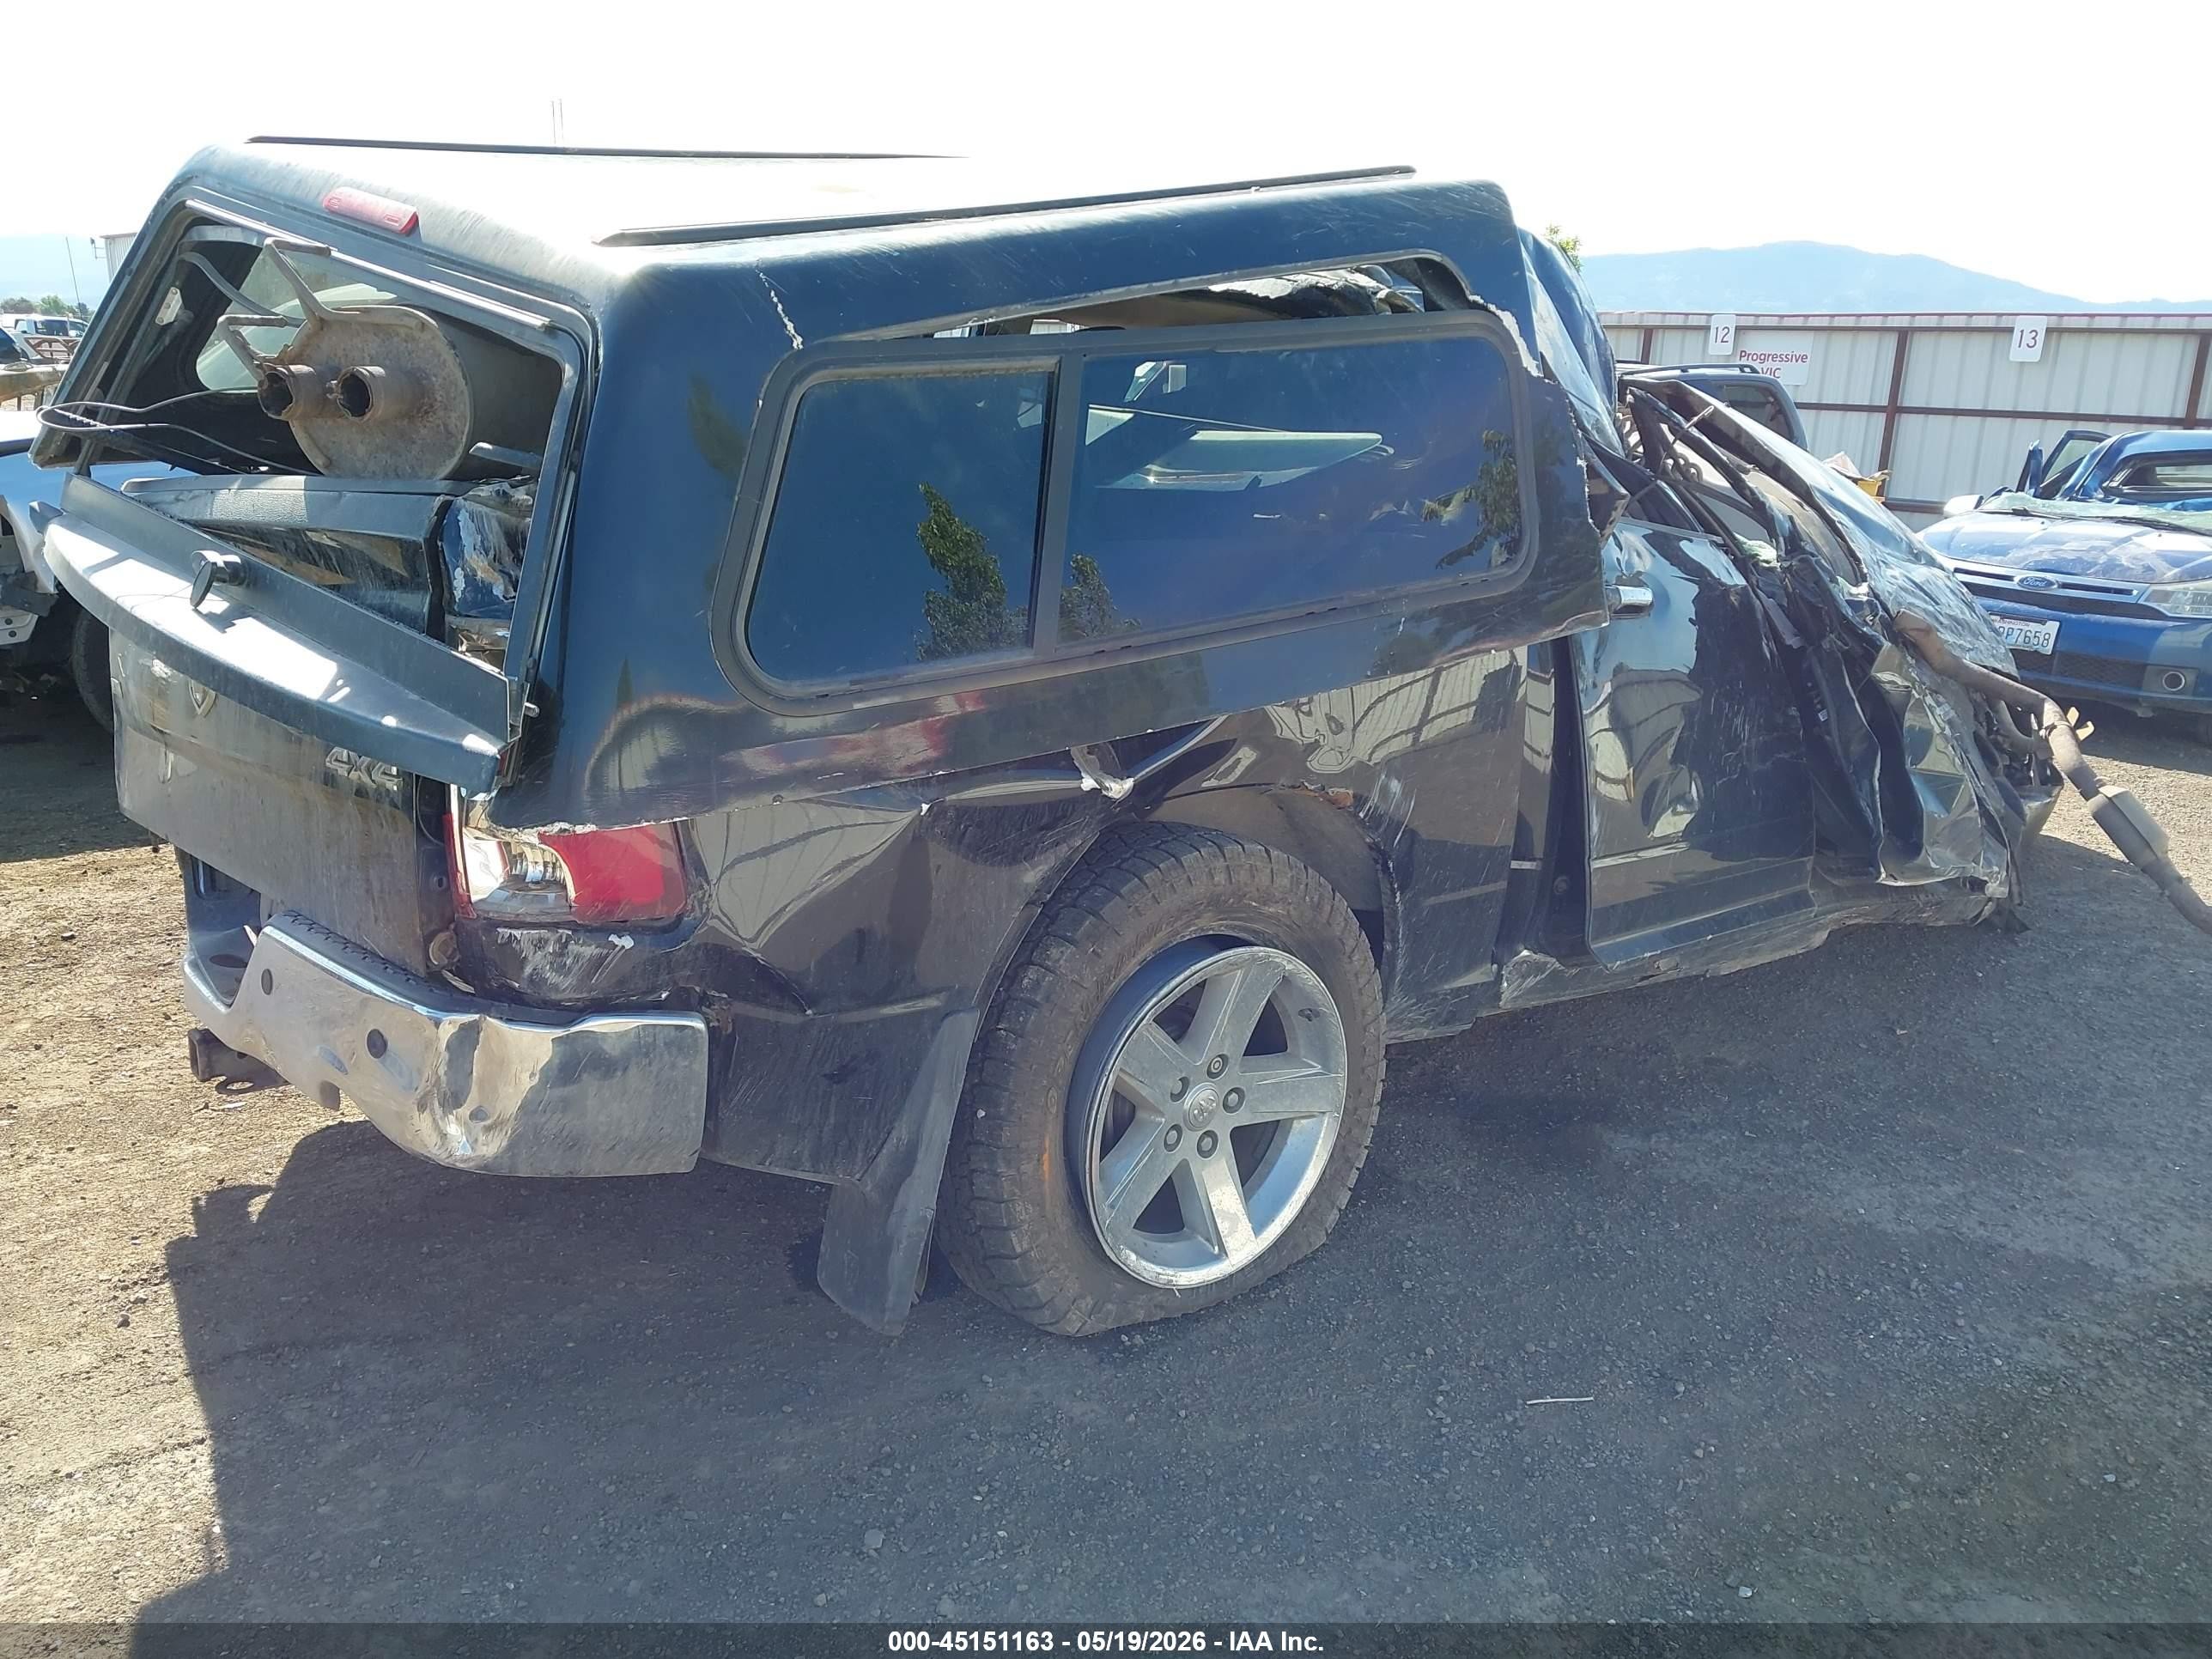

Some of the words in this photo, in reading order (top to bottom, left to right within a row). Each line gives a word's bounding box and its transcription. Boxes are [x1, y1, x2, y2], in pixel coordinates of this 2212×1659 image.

[1714, 325, 1730, 343] 12
[2018, 329, 2039, 349] 13
[1739, 349, 1808, 364] Progressive
[1760, 367, 1782, 379] VIC
[2023, 577, 2048, 587] Ford
